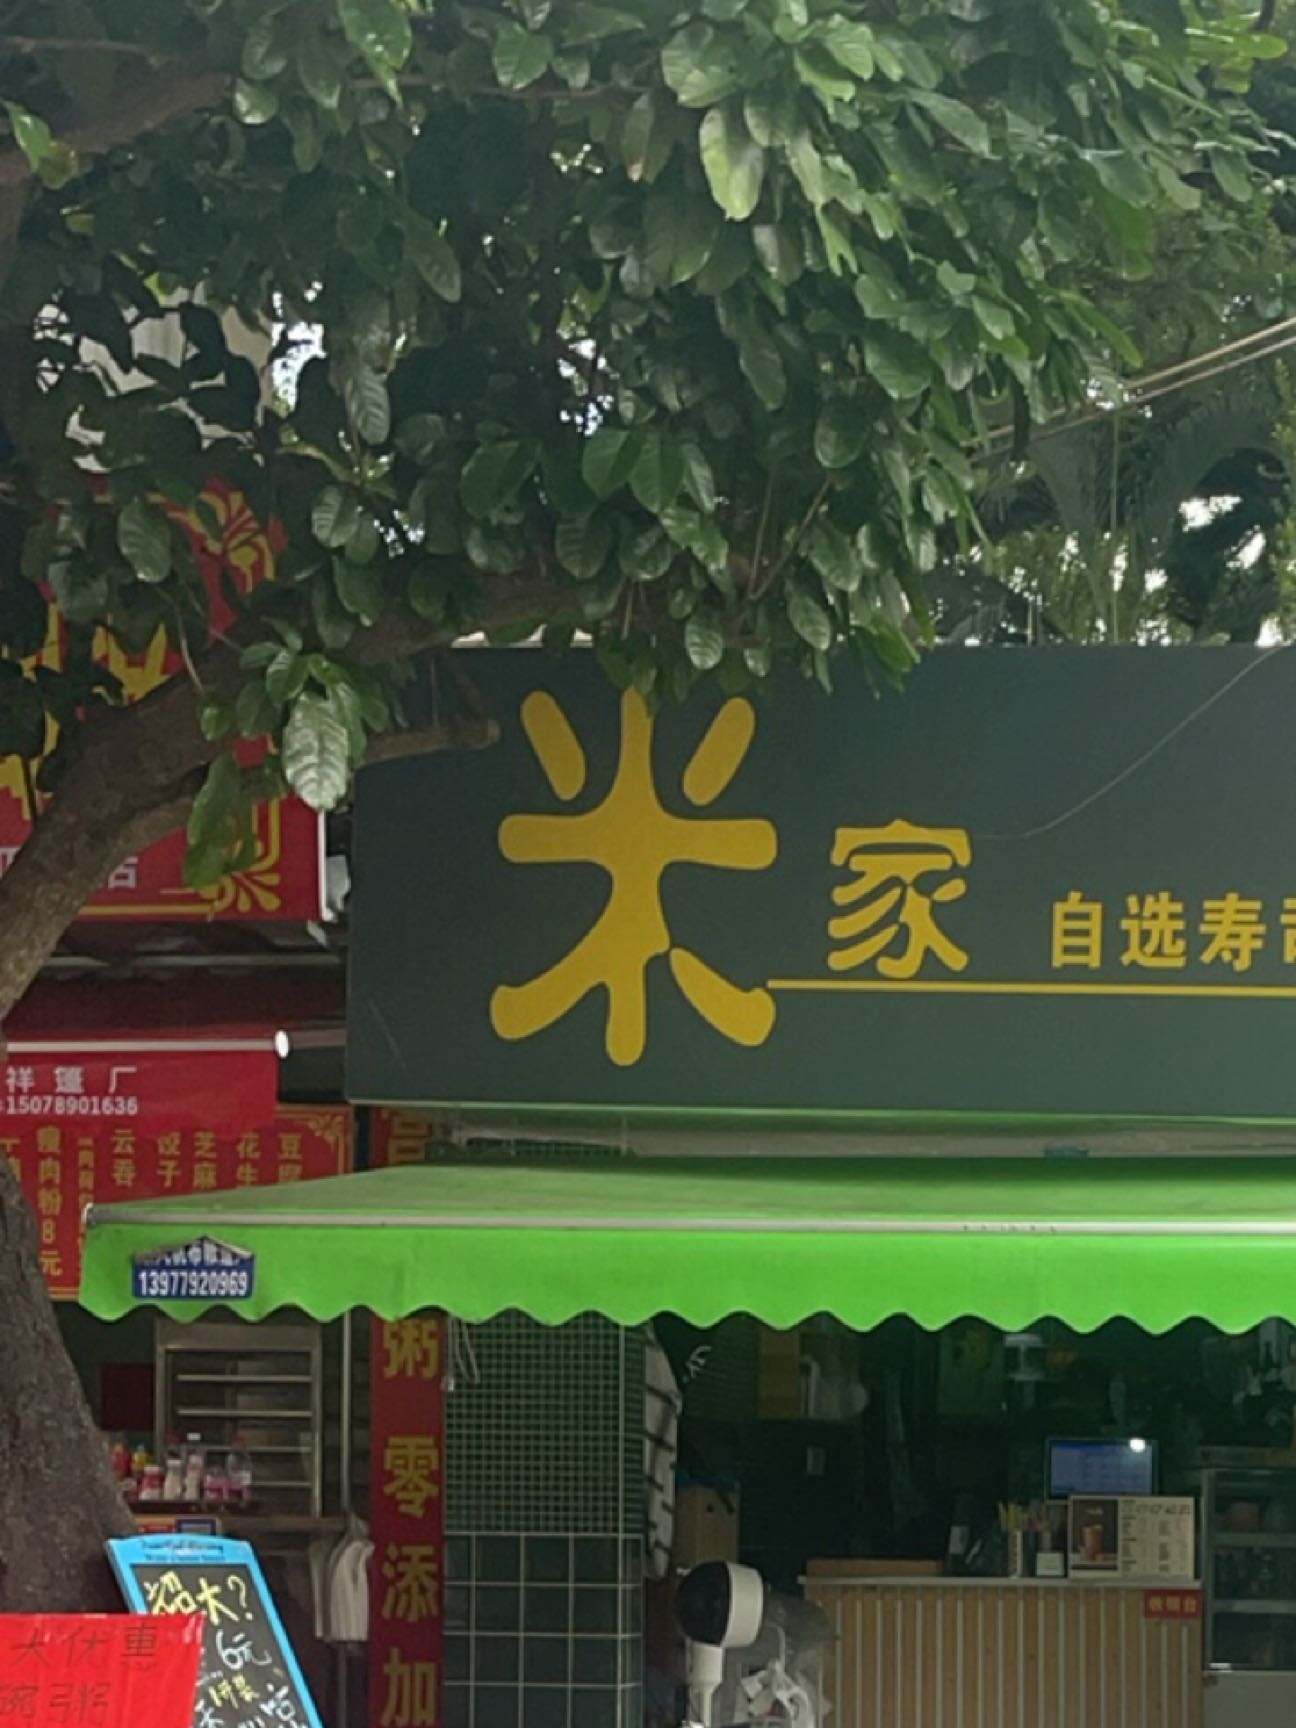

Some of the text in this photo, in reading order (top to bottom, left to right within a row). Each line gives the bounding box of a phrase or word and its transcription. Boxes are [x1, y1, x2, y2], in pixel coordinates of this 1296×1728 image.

[489, 686, 973, 1066] 米家
[138, 1270, 248, 1297] 13977920969
[380, 1318, 441, 1728] 粥零添加
